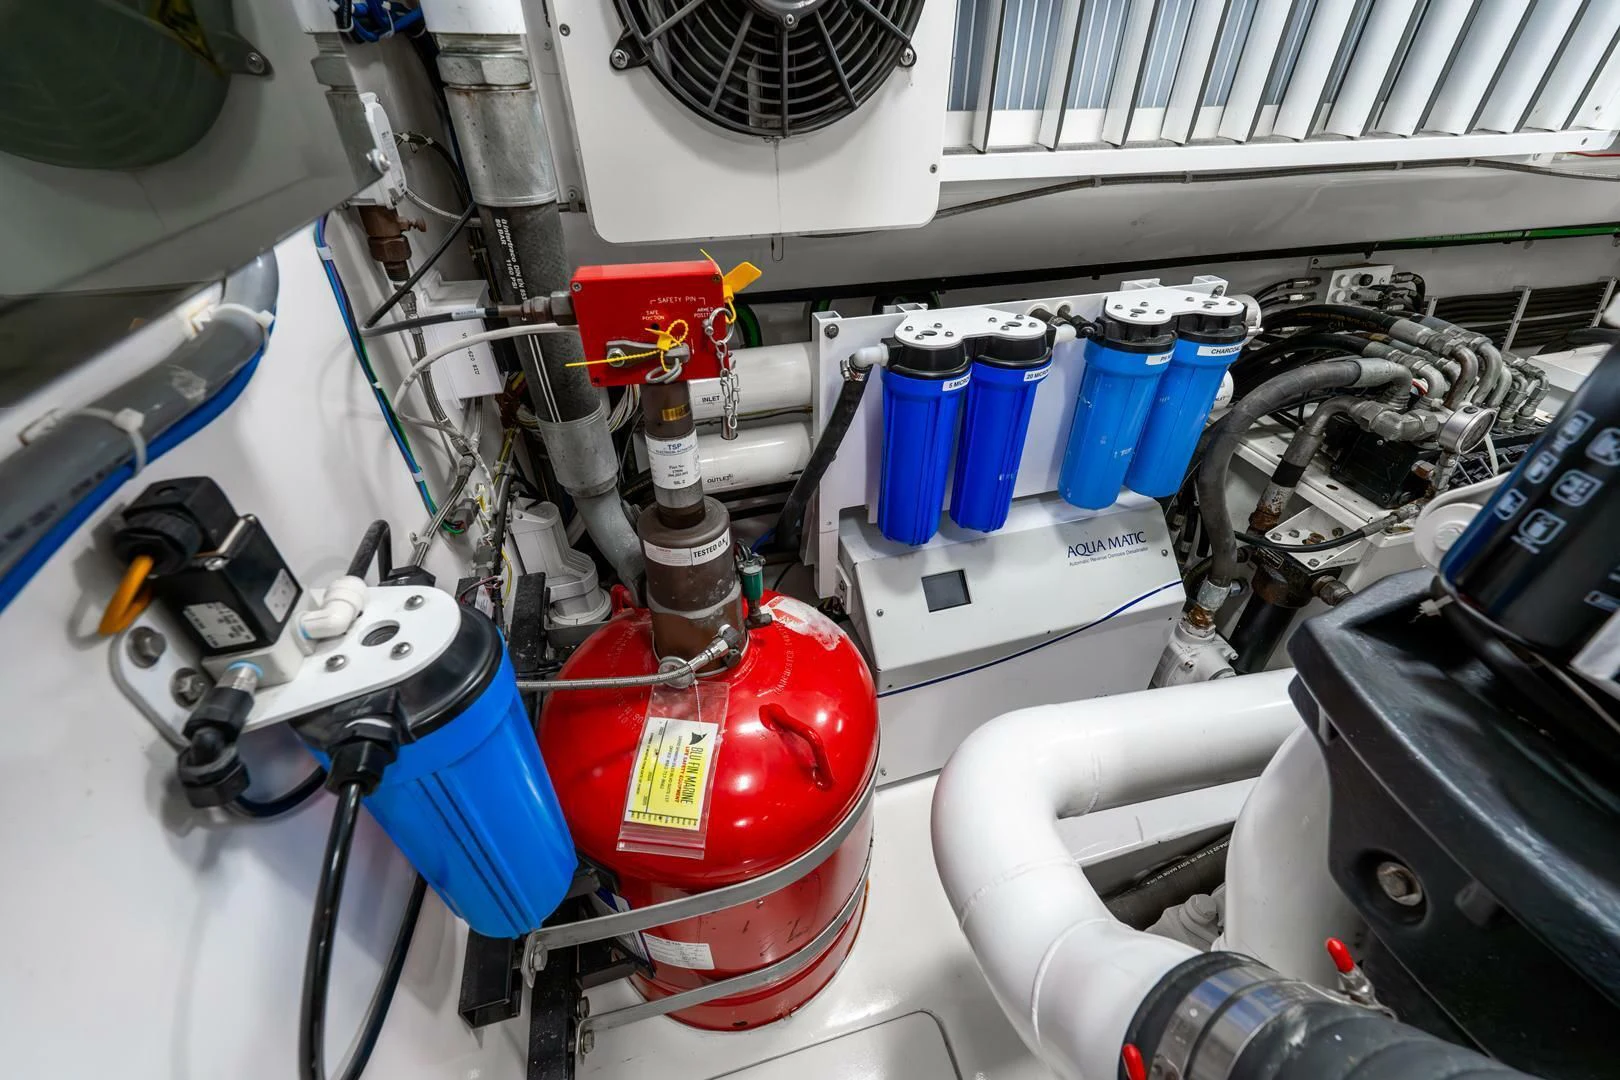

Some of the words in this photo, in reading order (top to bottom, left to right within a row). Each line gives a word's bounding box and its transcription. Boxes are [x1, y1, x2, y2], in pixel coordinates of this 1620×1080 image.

[498, 229, 506, 245] BAR
[517, 278, 524, 288] EN
[1034, 369, 1049, 378] MICRO
[954, 376, 969, 386] MICRO
[693, 544, 717, 558] TESTED
[1068, 540, 1106, 558] AQUA
[1108, 531, 1146, 549] MATIC
[689, 746, 703, 760] BLU
[686, 761, 700, 774] FIN
[675, 774, 683, 802] EQUIPMENT
[681, 774, 697, 804] MARINE
